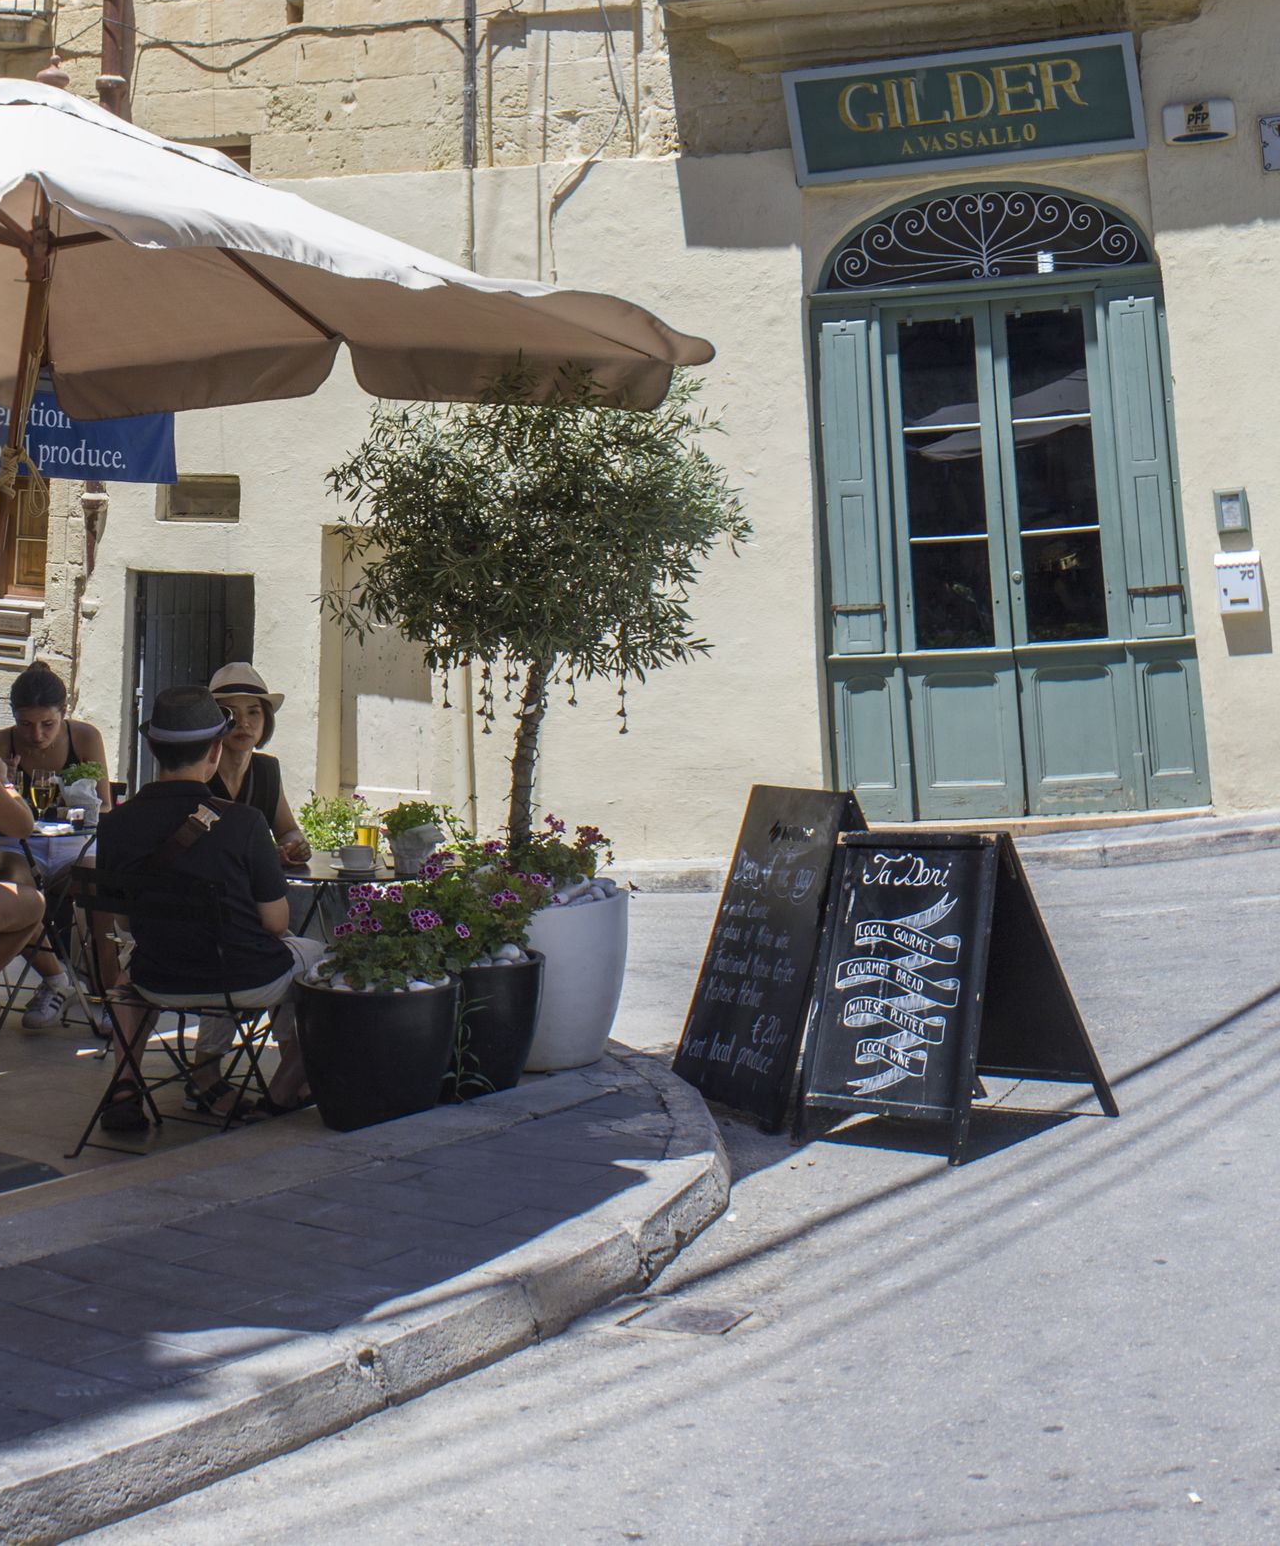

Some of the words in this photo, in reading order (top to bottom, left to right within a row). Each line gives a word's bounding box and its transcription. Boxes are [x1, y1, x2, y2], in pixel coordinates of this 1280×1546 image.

[837, 58, 1089, 134] GILDER
[1187, 111, 1210, 126] PFP
[37, 439, 126, 471] produce.
[1239, 569, 1255, 581] 70
[858, 924, 887, 937] LOCAL
[893, 927, 936, 955] GOURMET
[846, 961, 891, 976] GOURMET
[895, 968, 924, 992] BREAD
[848, 999, 885, 1016] MALTESE
[889, 1008, 925, 1036] PLATTER
[861, 1042, 886, 1057] LOCAL
[889, 1048, 911, 1069] WINE
